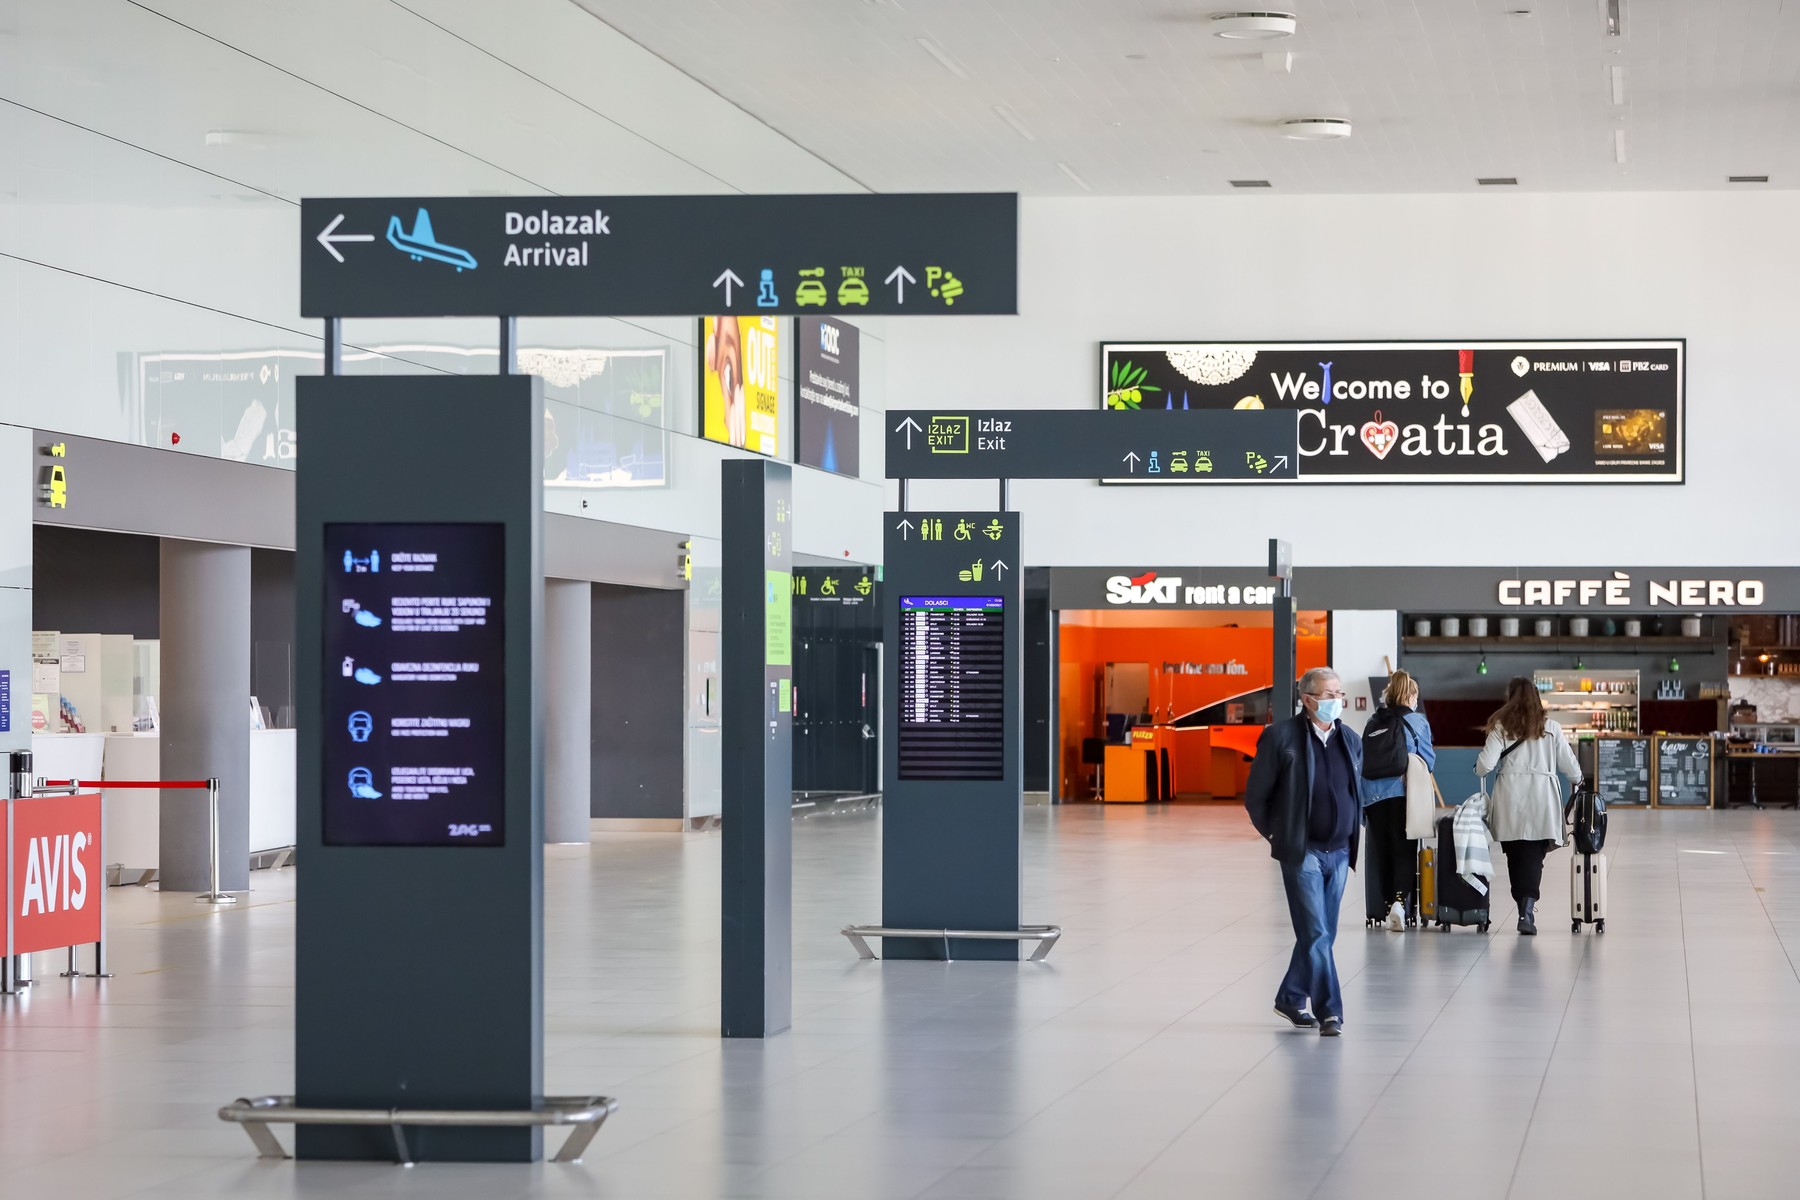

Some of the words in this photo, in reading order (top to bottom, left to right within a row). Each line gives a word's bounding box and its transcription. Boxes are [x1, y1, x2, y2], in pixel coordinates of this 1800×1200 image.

[505, 209, 610, 235] Dolazak
[504, 241, 588, 267] Arrival
[840, 266, 864, 276] TAXI
[747, 326, 775, 390] OUT
[1533, 362, 1578, 372] PREMIUM
[1588, 362, 1610, 372] VISA
[1632, 361, 1649, 371] PBZ
[1270, 362, 1411, 404] Welcome
[1421, 375, 1450, 400] to
[928, 424, 961, 434] IZLAZ
[978, 417, 1012, 432] Izlaz
[928, 435, 954, 445] EXIT
[978, 437, 1006, 450] Exit
[1185, 585, 1225, 604] rent
[1228, 586, 1240, 604] a
[1243, 586, 1276, 604] car
[1498, 570, 1631, 606] CAFFÈ
[1649, 580, 1764, 606] NERO
[21, 831, 87, 917] AVIS
